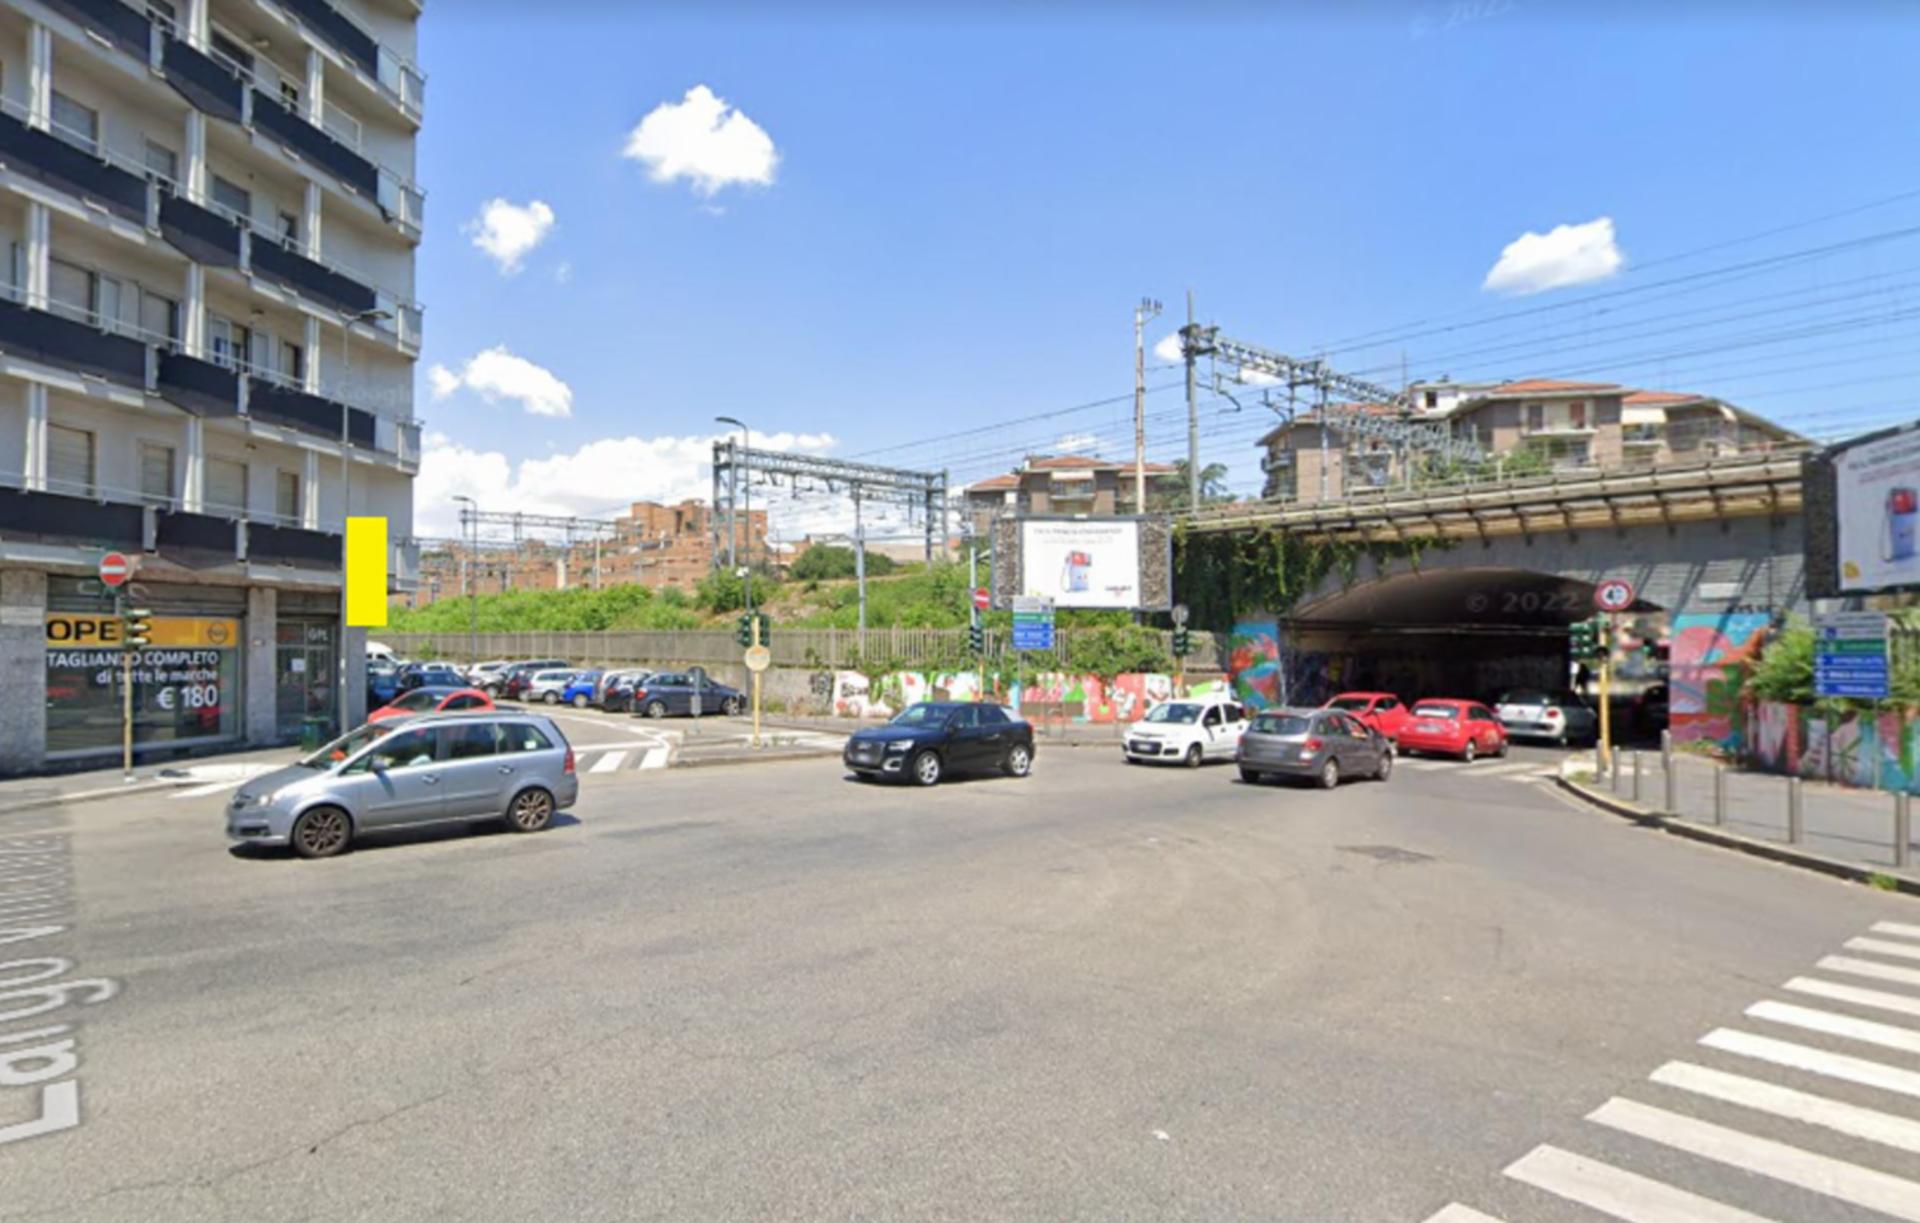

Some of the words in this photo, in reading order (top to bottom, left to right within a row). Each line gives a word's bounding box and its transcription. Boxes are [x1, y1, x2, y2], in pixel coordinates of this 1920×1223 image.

[46, 618, 120, 641] OPE
[144, 651, 218, 666] COMPLETO
[96, 669, 112, 684] di
[115, 670, 152, 684] ttte
[155, 670, 169, 683] le
[170, 668, 218, 682] marche
[157, 687, 175, 709] €
[180, 685, 218, 708] 180
